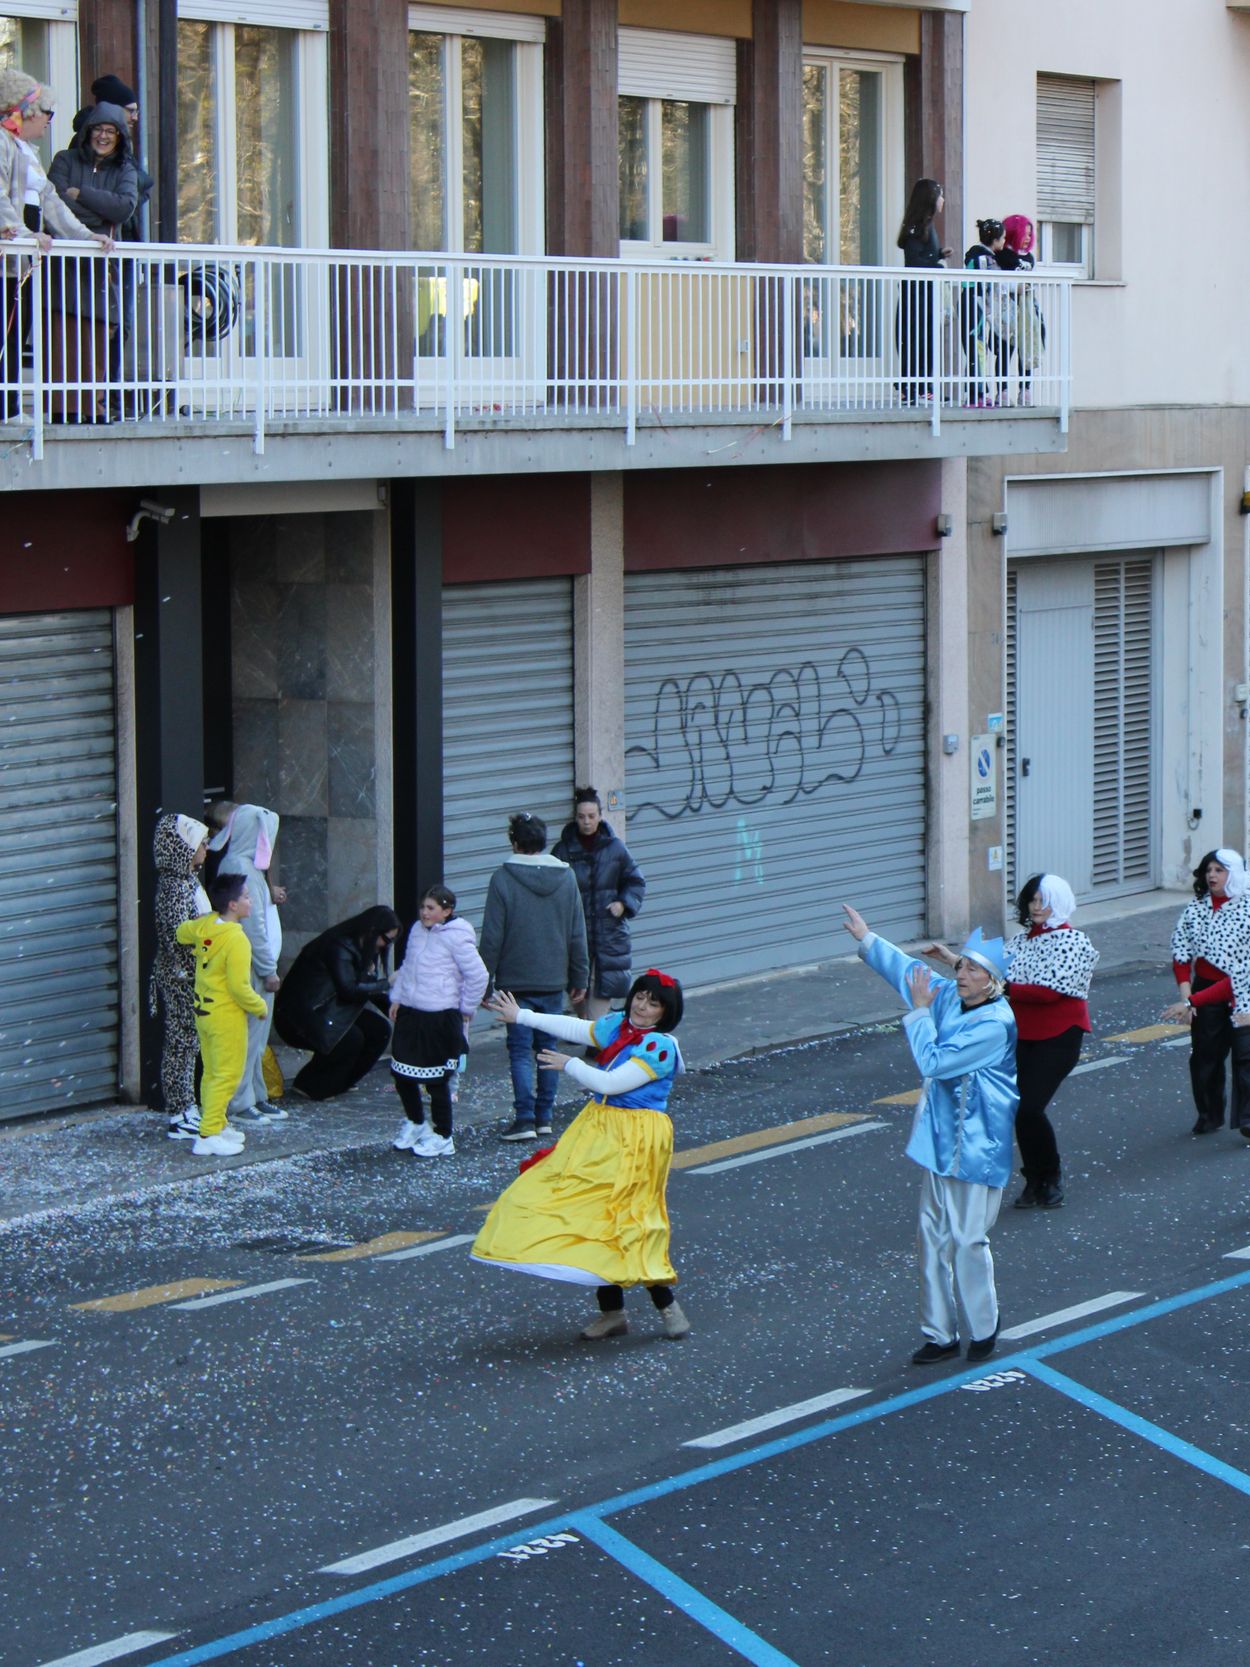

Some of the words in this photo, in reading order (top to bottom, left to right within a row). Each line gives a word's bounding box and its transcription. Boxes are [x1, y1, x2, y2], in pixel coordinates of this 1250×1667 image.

[976, 786, 991, 795] passo
[973, 794, 995, 805] carrabile
[496, 1532, 580, 1560] 4221
